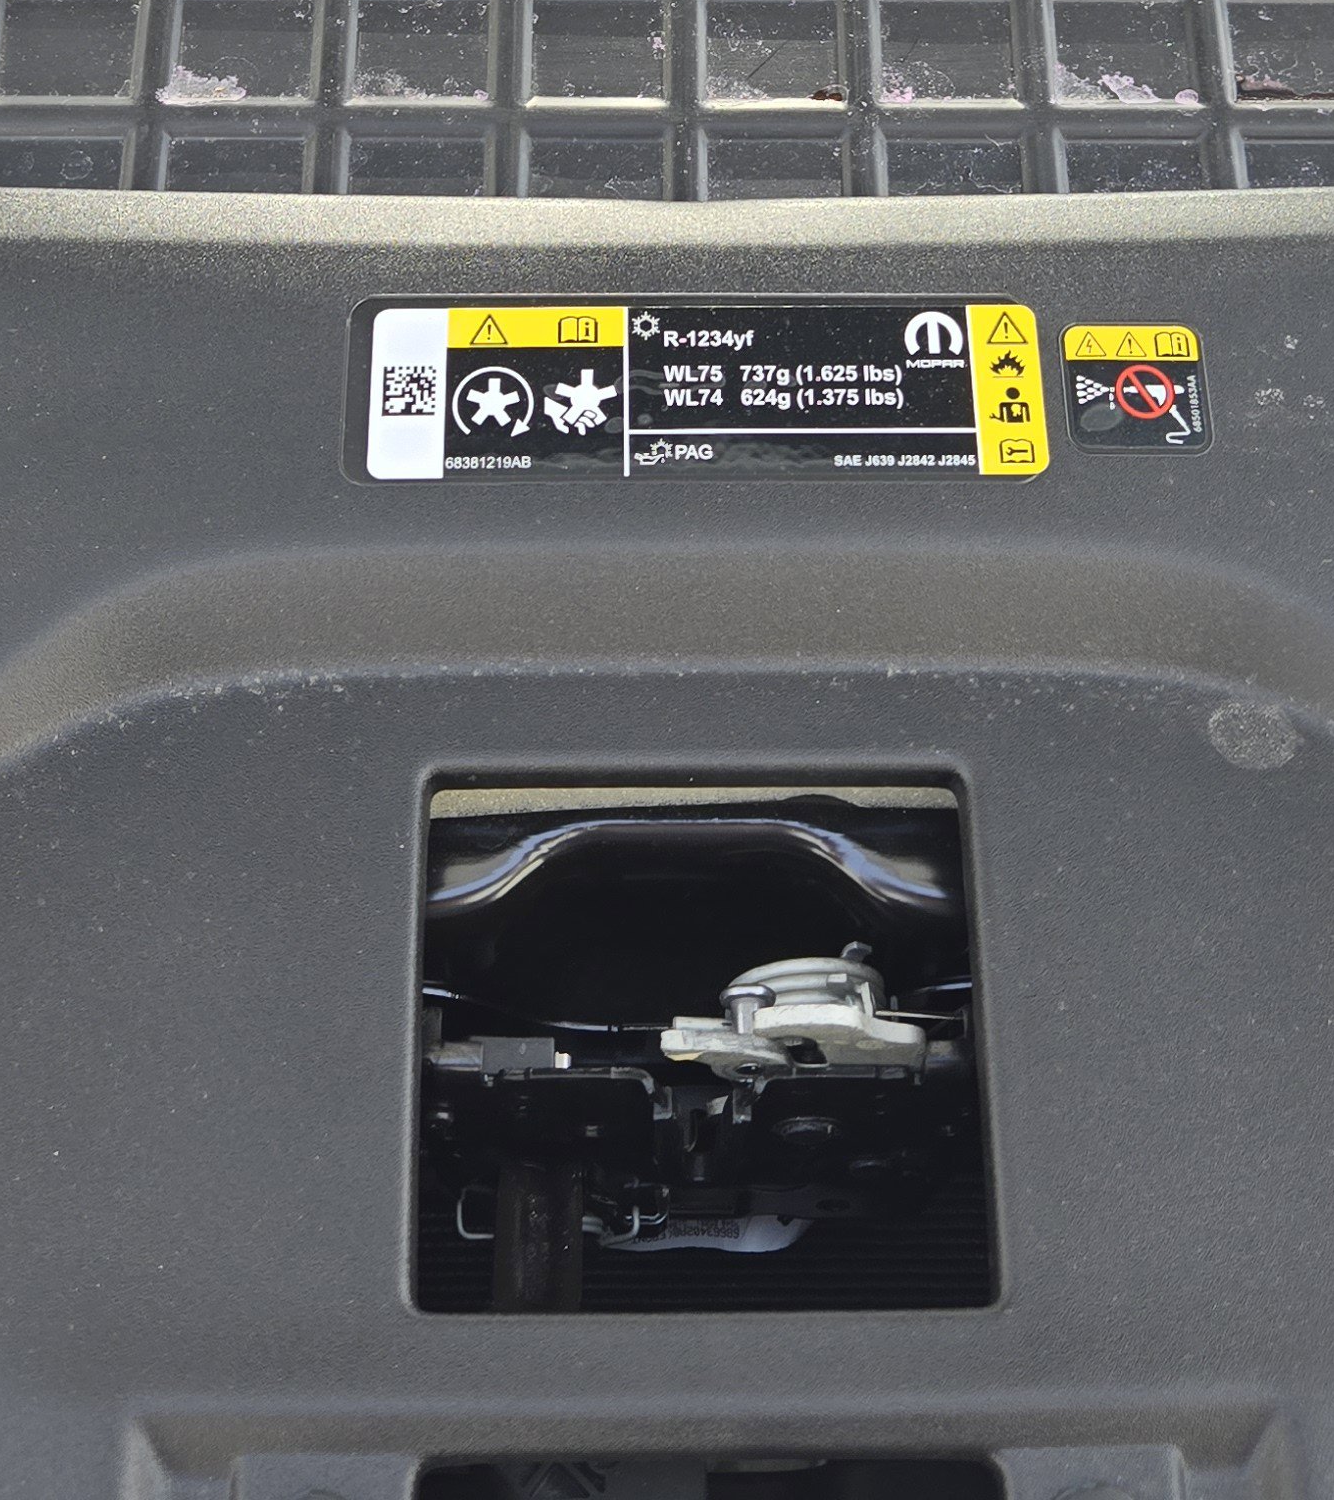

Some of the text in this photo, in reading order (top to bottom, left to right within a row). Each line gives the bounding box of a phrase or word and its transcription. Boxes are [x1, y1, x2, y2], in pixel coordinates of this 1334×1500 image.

[663, 329, 755, 351] R-1234yf
[905, 358, 966, 369] MOPAR
[663, 364, 903, 386] WL75 737g (1.625 lbs)
[664, 387, 905, 410] WL74 624g (1.375 lbs)
[1186, 374, 1203, 433] 68501853AA
[444, 455, 532, 469] 68381219AB
[674, 444, 714, 461] PAG
[833, 454, 976, 467] SAE J639 J2842 J2845
